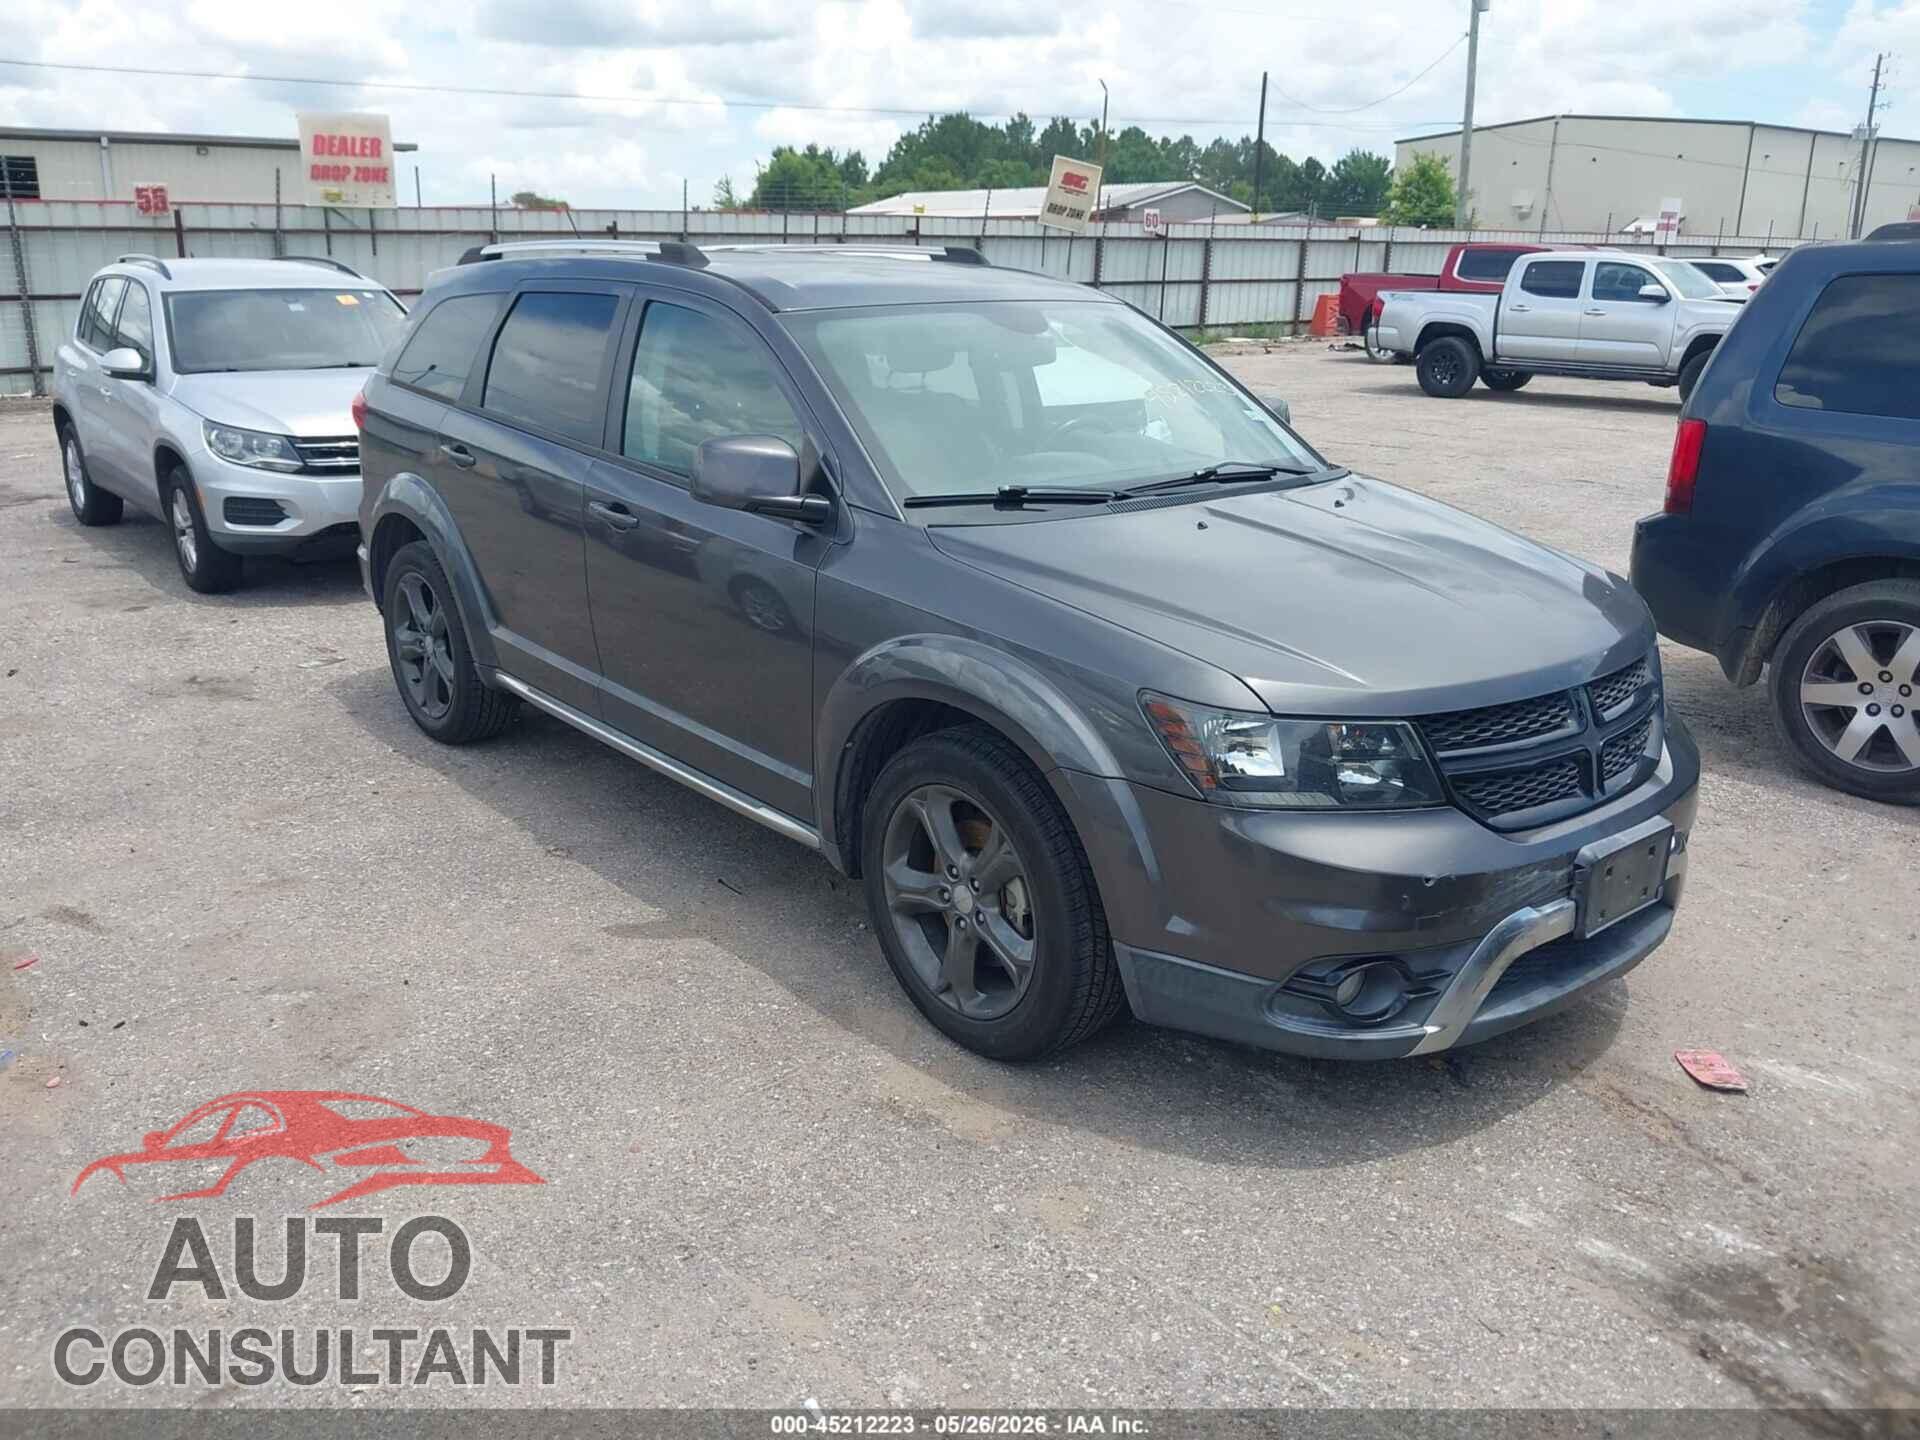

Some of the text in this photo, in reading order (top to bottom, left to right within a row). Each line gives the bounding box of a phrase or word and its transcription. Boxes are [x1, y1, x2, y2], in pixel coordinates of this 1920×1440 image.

[312, 134, 382, 158] DEALER
[310, 164, 389, 184] DROP ZONE
[1145, 212, 1159, 229] 60
